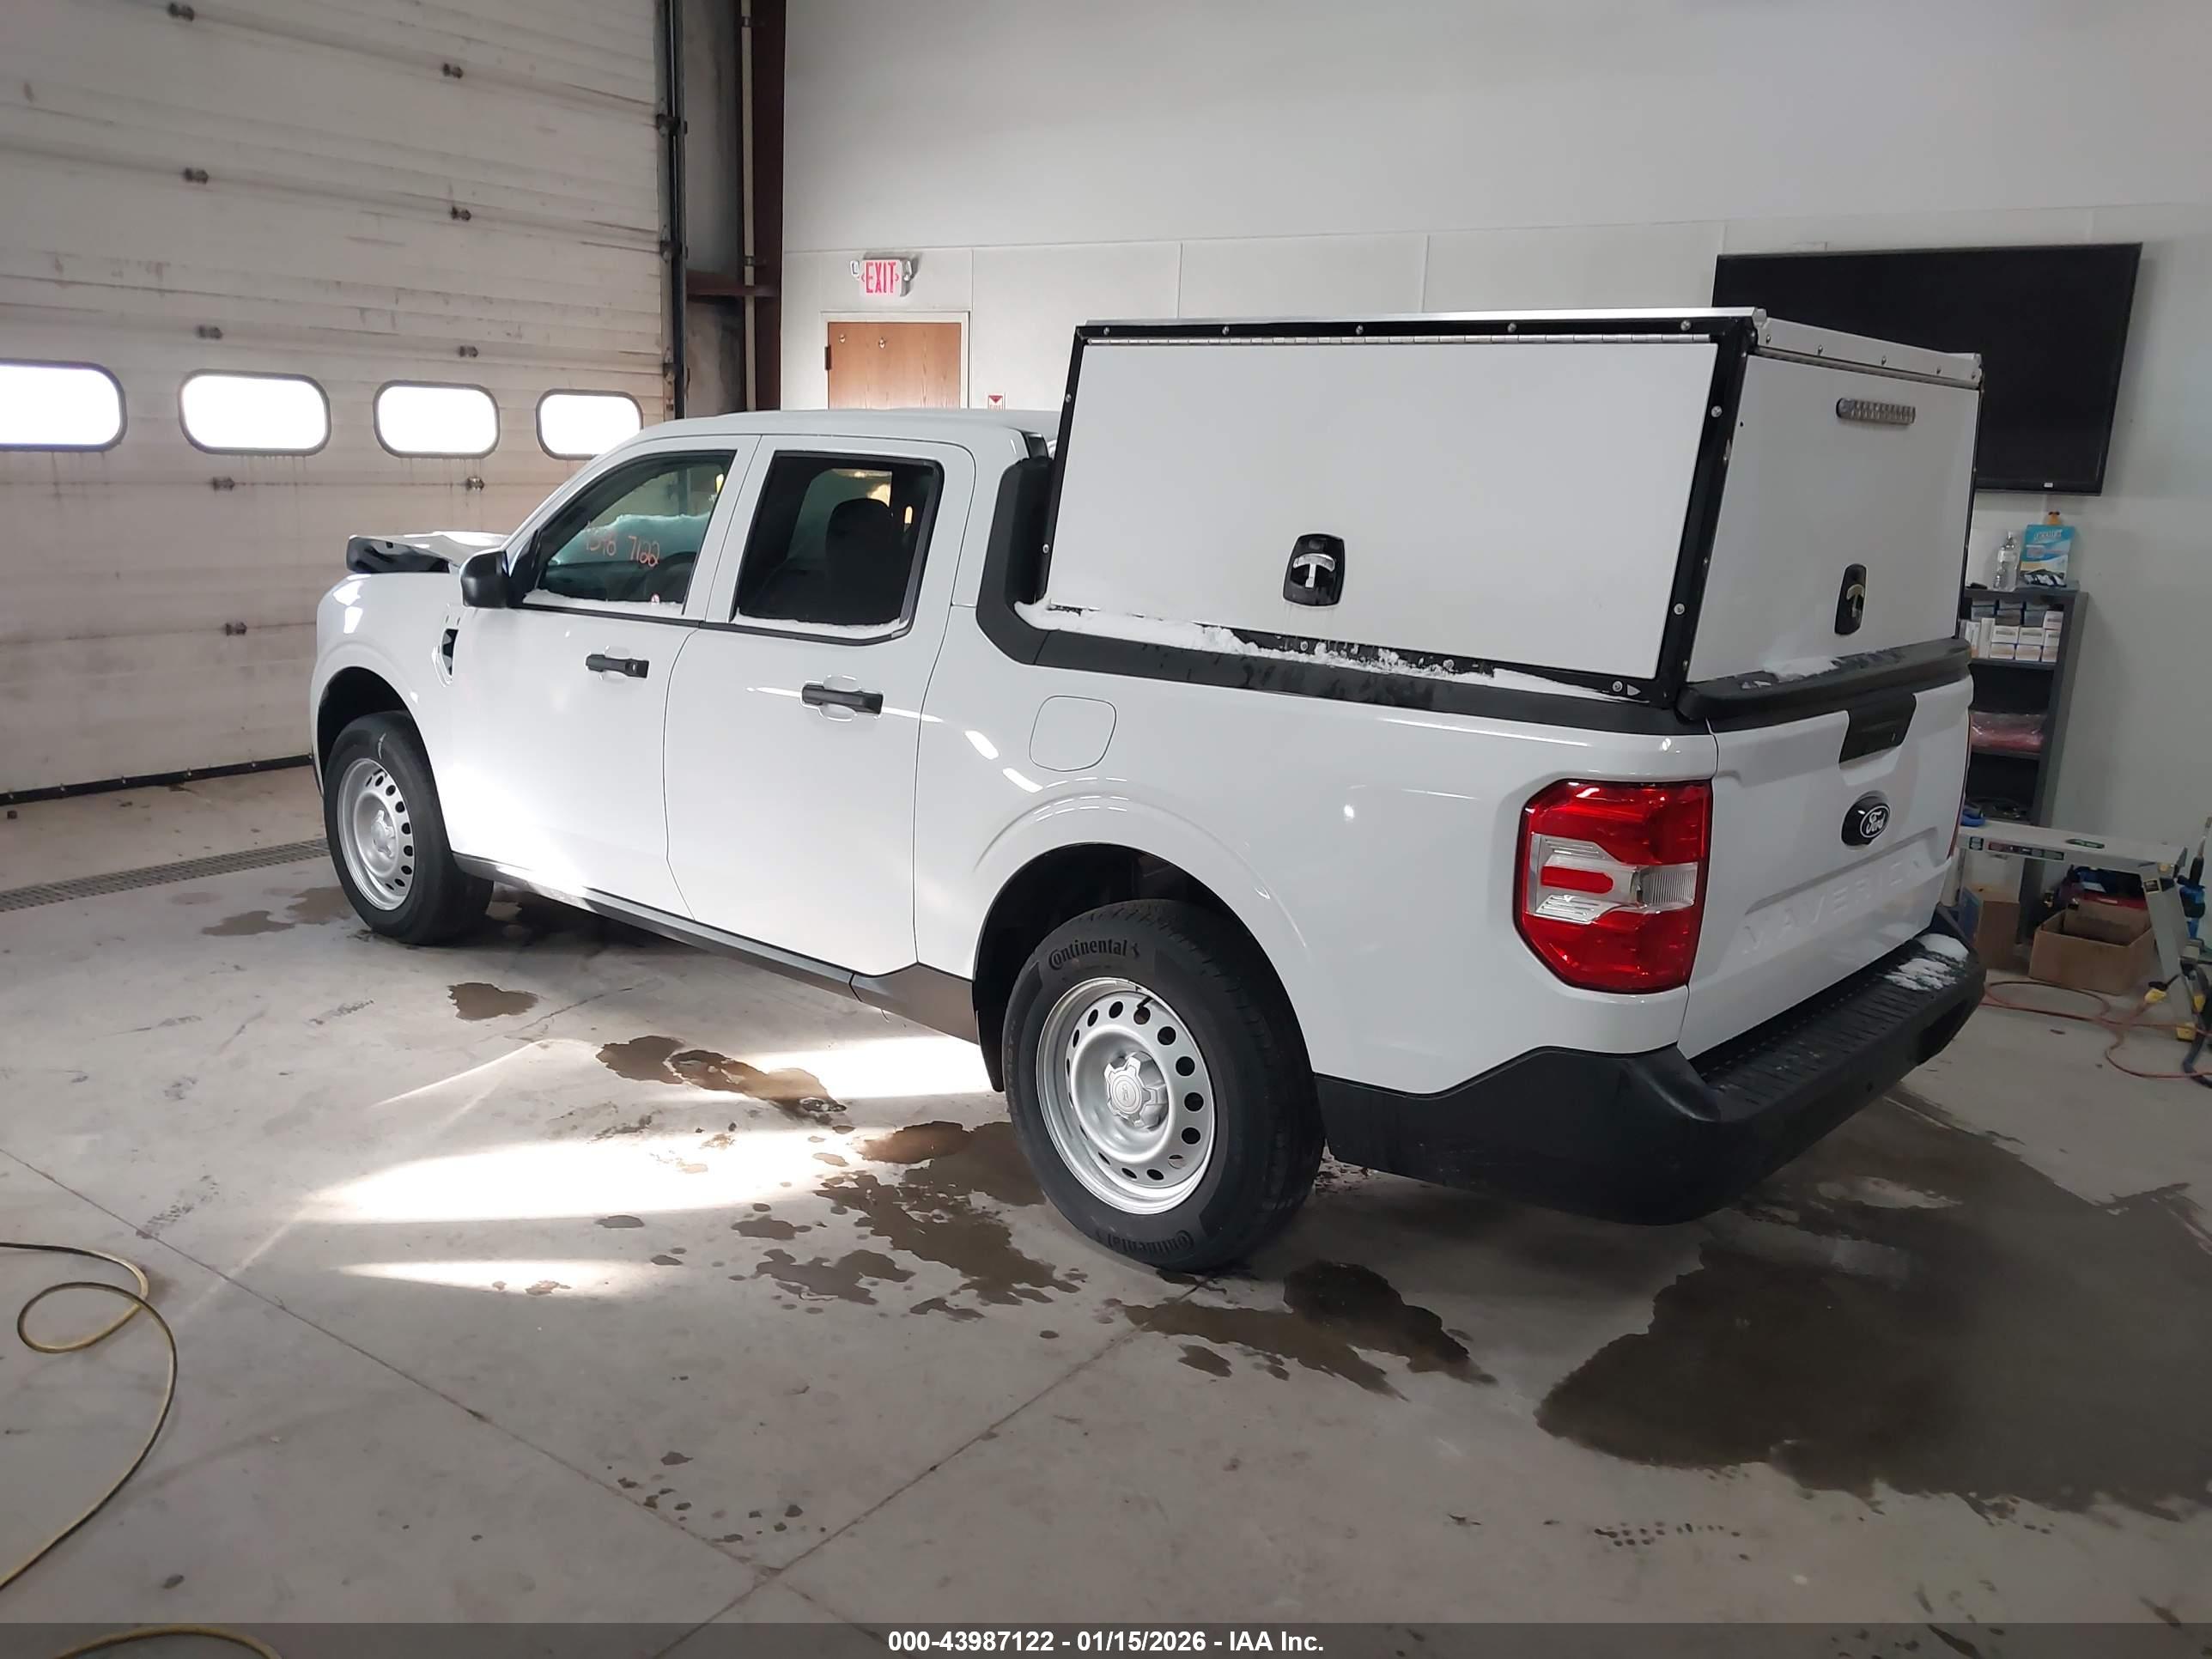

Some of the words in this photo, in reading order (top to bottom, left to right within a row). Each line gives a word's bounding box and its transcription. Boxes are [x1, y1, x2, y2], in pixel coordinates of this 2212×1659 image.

[866, 261, 896, 294] EXIT
[628, 535, 661, 568] 7122
[1864, 809, 1887, 836] Ford
[1048, 939, 1128, 971] Continental
[1107, 1229, 1194, 1254] Continental
